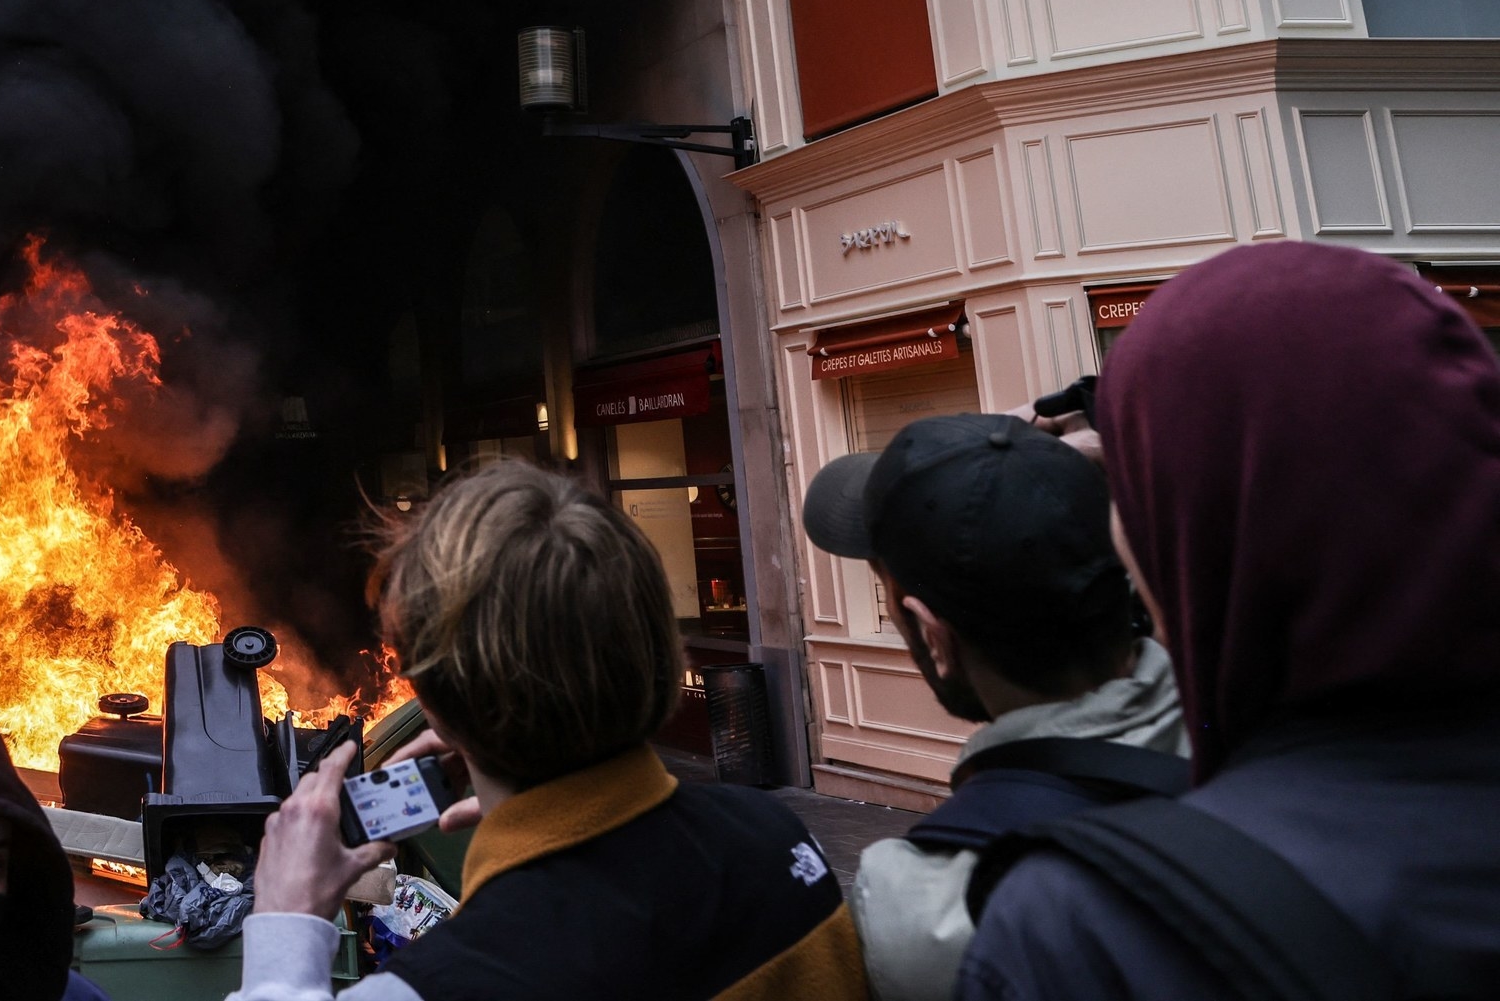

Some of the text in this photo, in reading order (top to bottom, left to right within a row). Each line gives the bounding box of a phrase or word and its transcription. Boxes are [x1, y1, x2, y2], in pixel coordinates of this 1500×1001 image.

[821, 340, 942, 372] CREPES ET GALETTES ARTISANALES
[638, 393, 685, 412] BAILLARDRAN
